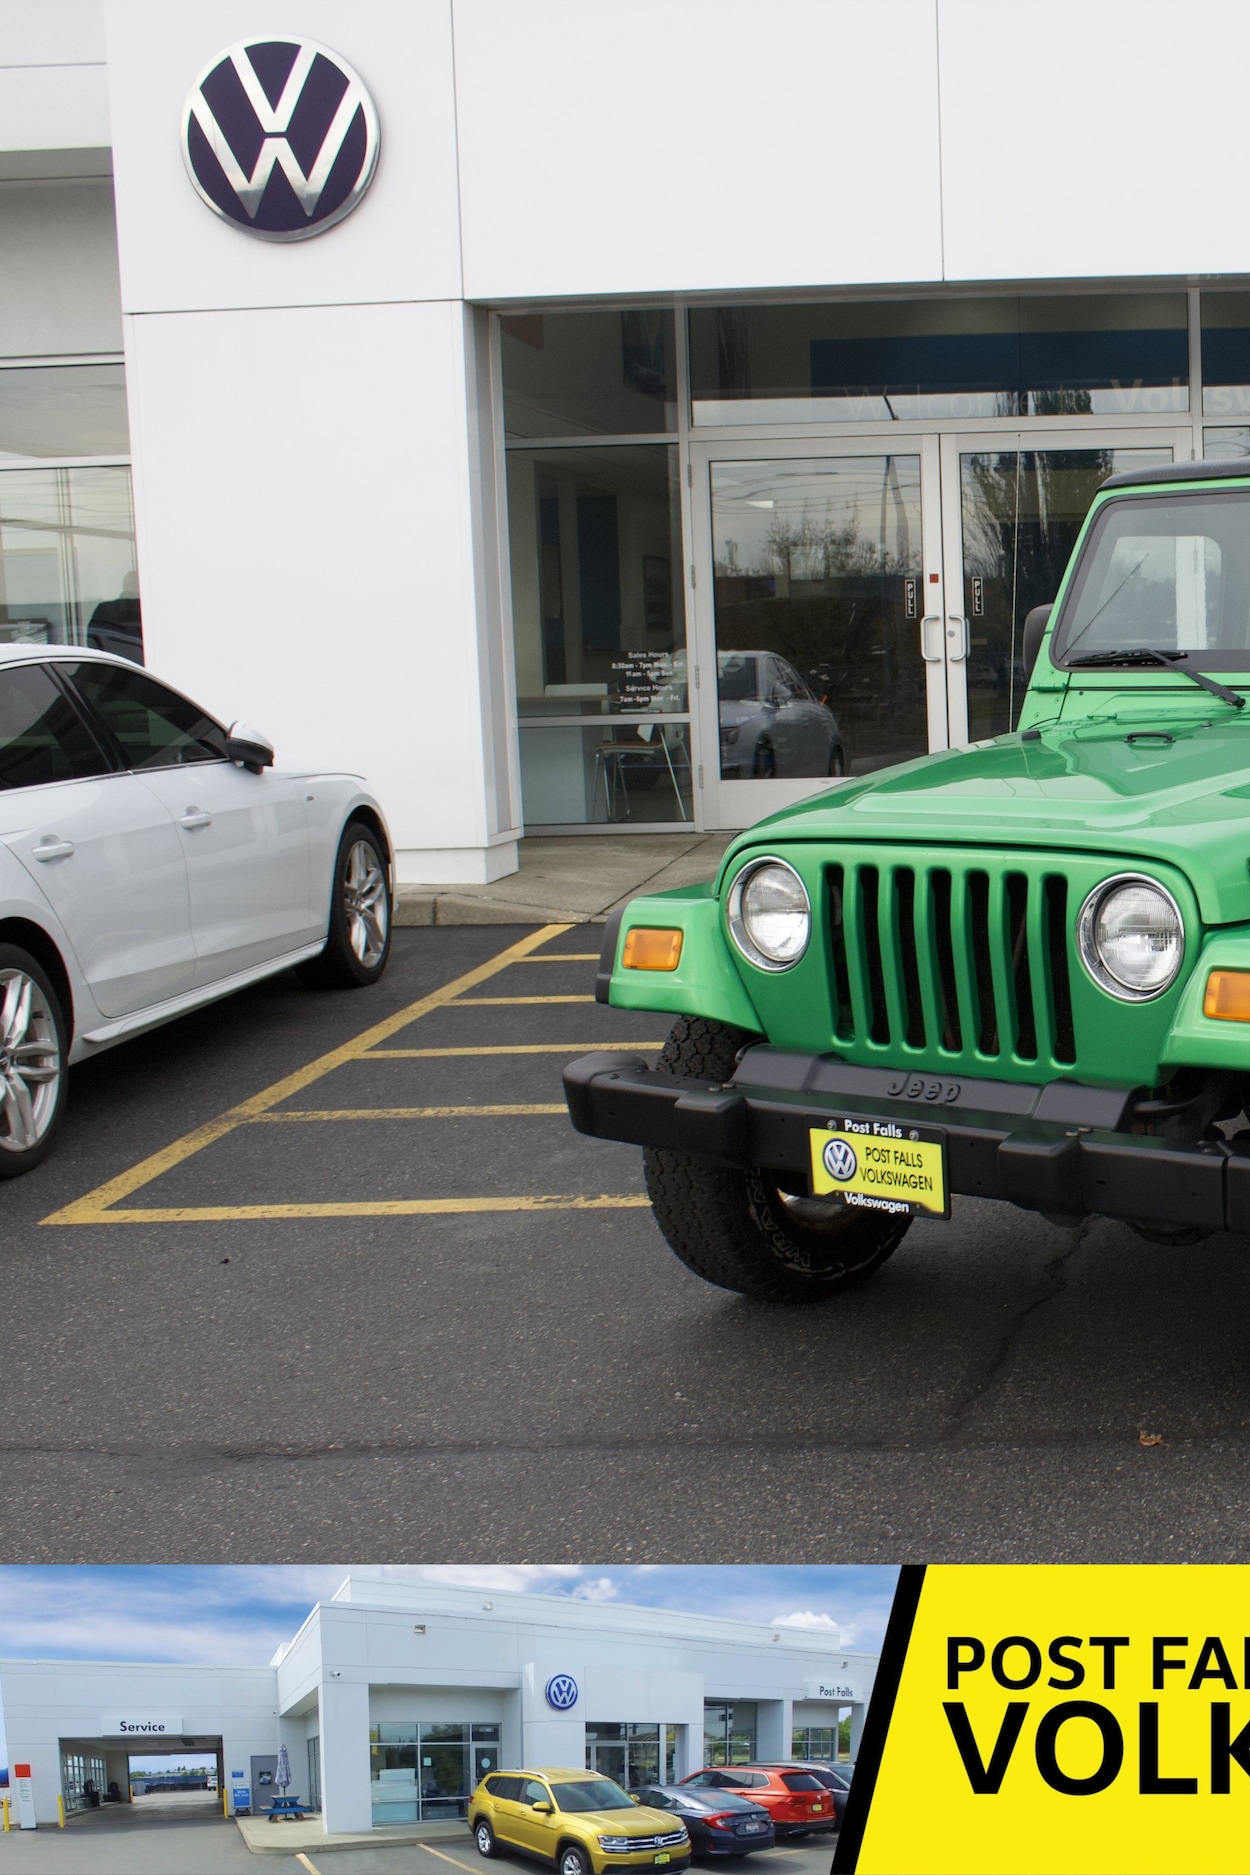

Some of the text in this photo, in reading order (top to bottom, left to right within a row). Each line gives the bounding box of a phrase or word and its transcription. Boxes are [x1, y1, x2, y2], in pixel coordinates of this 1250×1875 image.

[887, 1072, 961, 1105] Jeep
[843, 1118, 903, 1139] Post Falls
[865, 1146, 923, 1168] POST FALLS
[859, 1166, 933, 1192] VOLKSWAGEN
[844, 1191, 910, 1214] Volkswagen
[819, 1685, 853, 1698] Post Falls
[119, 1720, 166, 1732] Service
